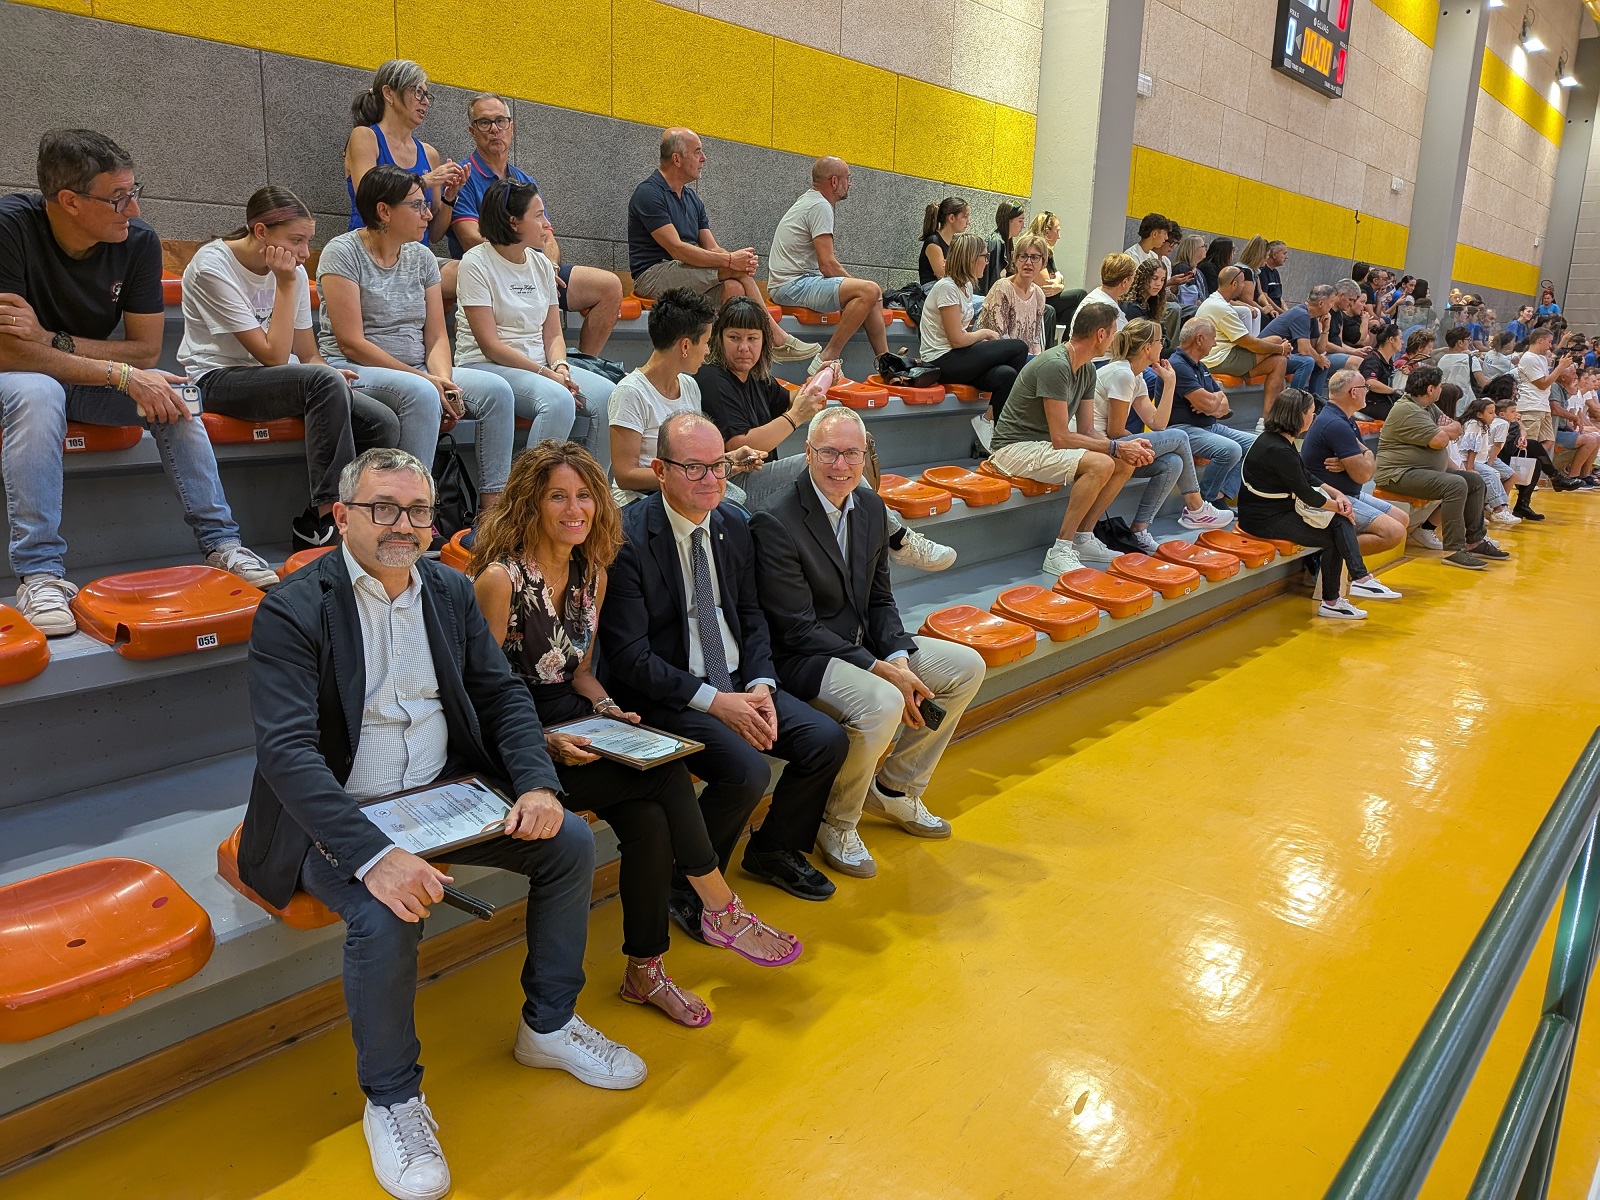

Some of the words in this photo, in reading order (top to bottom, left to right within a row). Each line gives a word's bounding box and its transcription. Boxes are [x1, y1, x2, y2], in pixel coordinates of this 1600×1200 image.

[255, 430, 268, 438] 106
[68, 438, 83, 447] 105
[198, 635, 216, 646] 055
